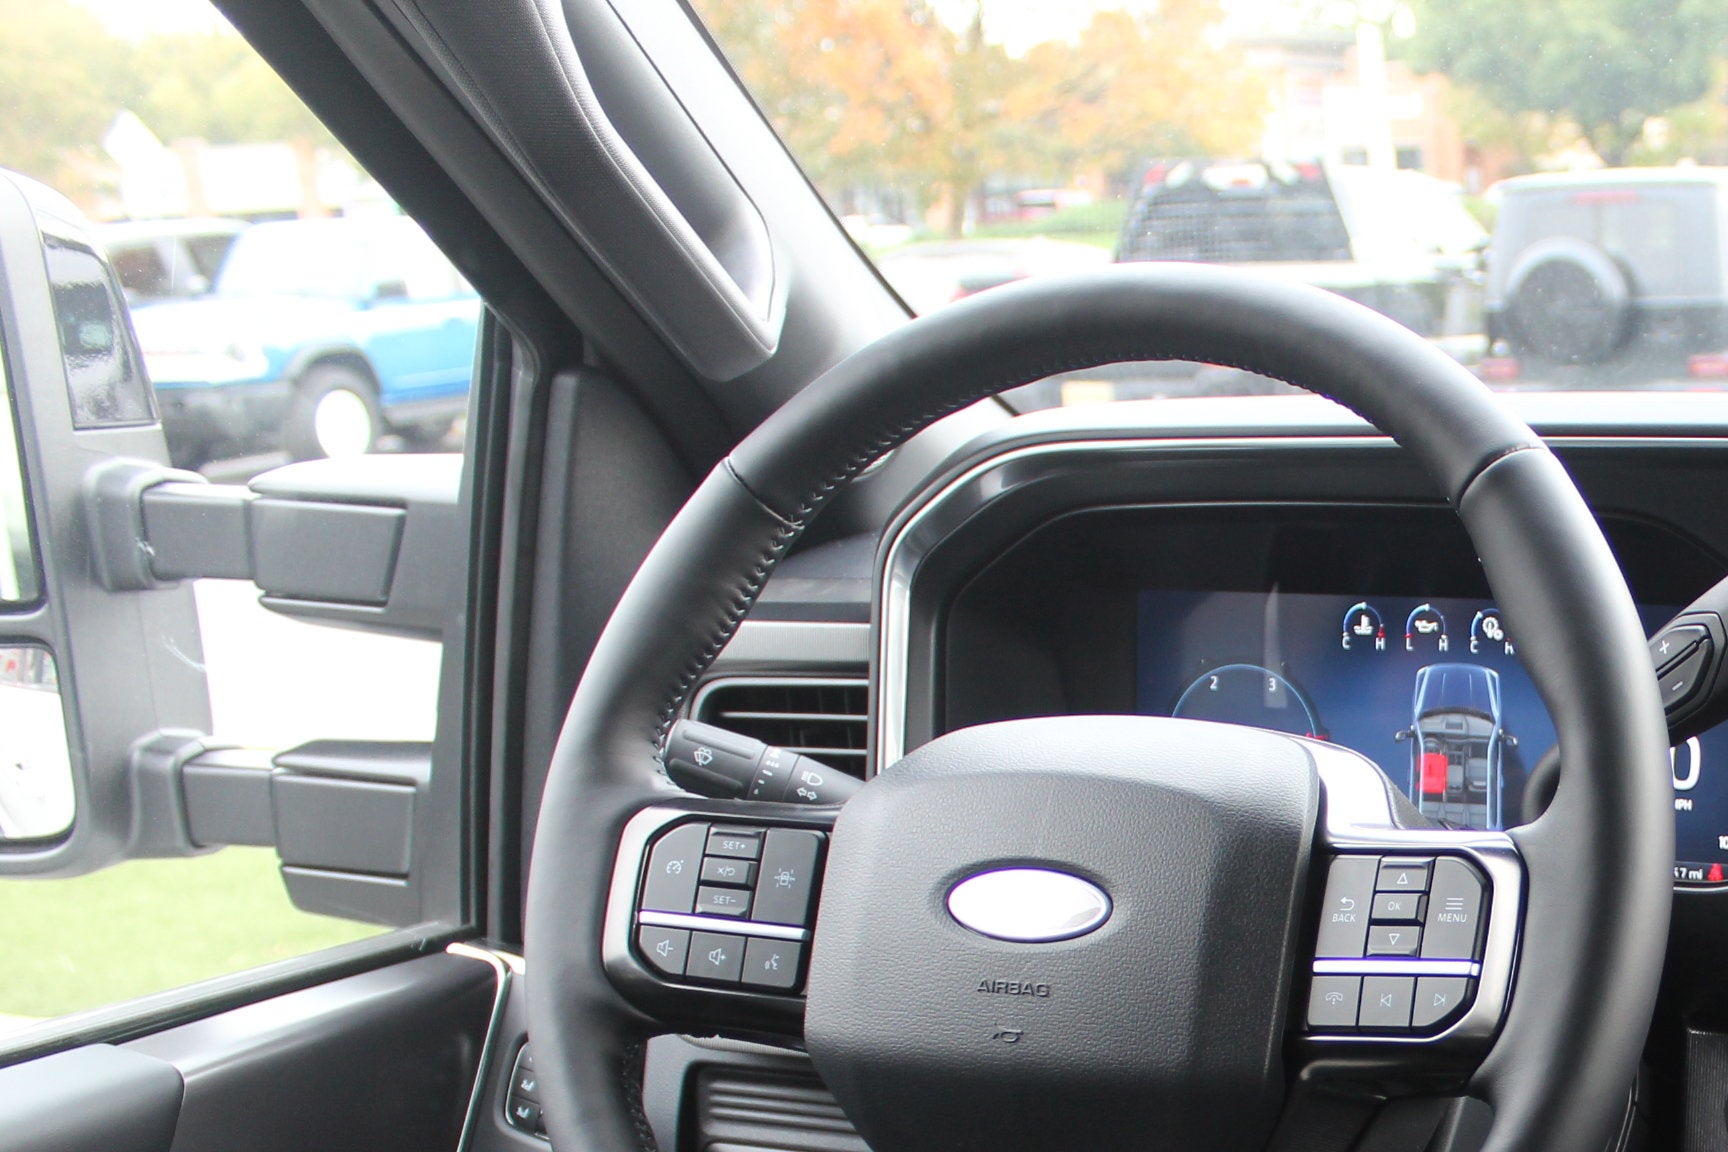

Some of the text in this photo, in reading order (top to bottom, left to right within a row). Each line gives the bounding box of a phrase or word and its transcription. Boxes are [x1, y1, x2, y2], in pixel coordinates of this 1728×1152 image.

[1342, 636, 1386, 650] C H
[1406, 637, 1448, 651] L H
[1470, 641, 1478, 653] C
[1210, 675, 1218, 690] 2
[1268, 677, 1276, 691] 3
[1688, 868, 1703, 880] mi
[1387, 901, 1401, 911] OK
[1331, 913, 1356, 923] BACK
[1437, 913, 1467, 923] MENU
[977, 980, 1050, 997] AIRBAG
